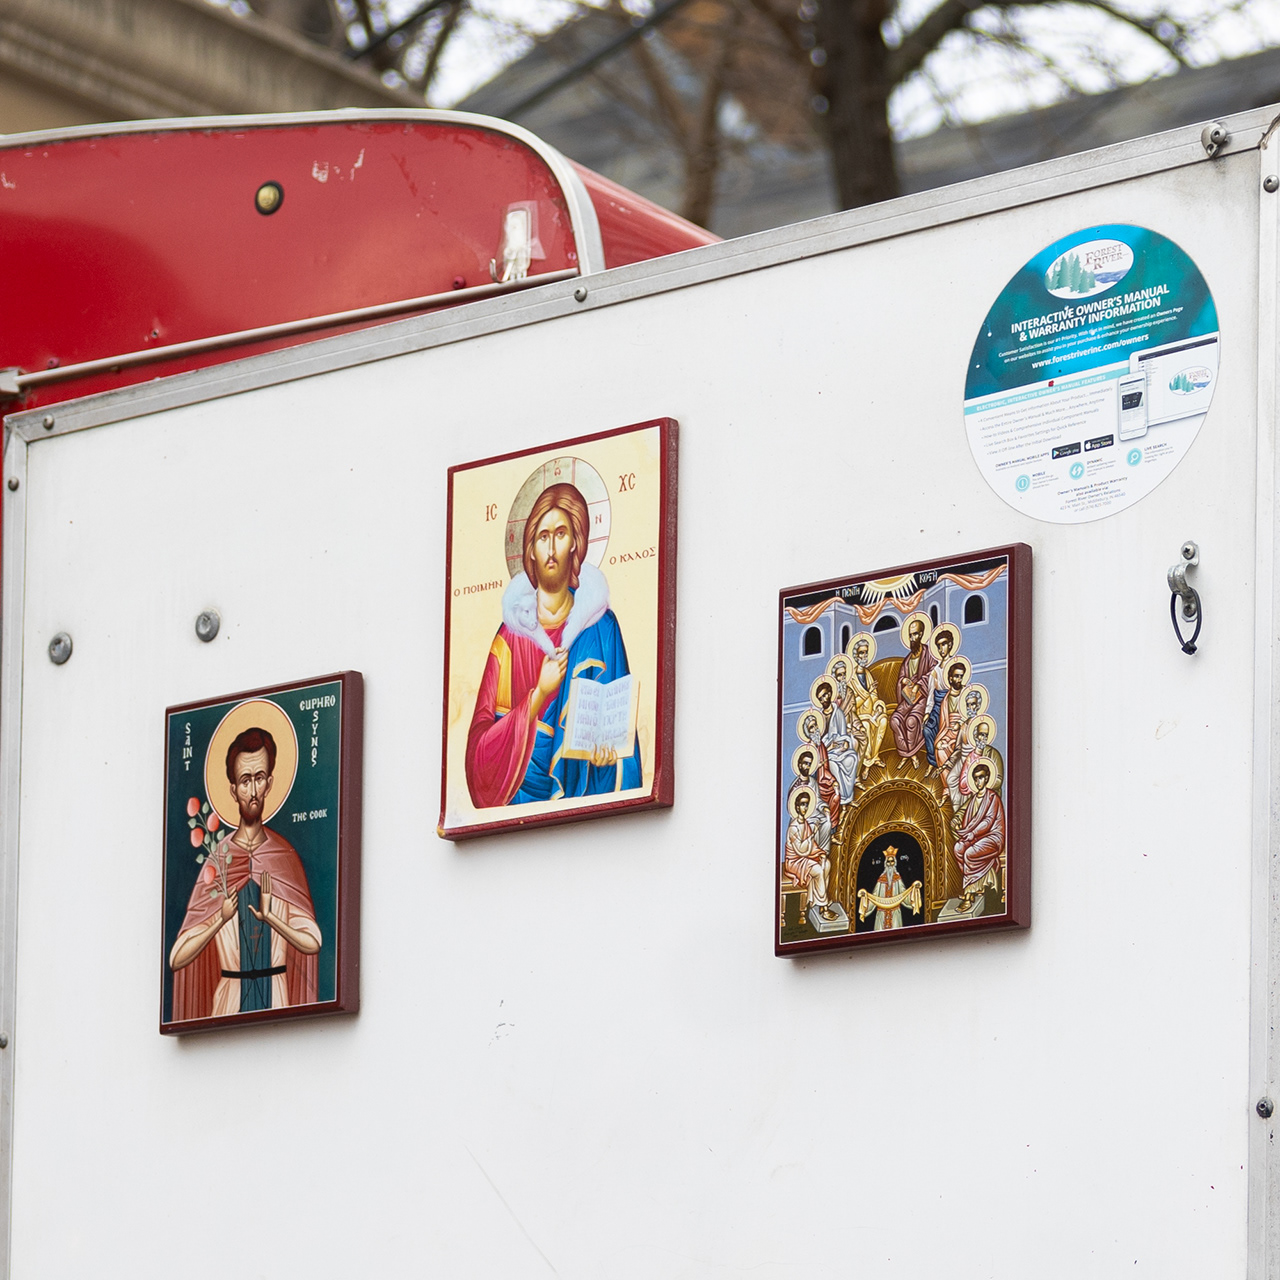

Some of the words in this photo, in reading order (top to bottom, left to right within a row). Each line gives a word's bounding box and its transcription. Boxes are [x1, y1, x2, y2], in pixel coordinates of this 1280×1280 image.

[1011, 311, 1074, 334] INTERACTIVE
[1076, 296, 1122, 318] OWNER'S
[1124, 284, 1170, 305] MANUAL
[1019, 331, 1028, 342] &
[1028, 317, 1087, 340] WARRANTY
[1088, 297, 1161, 322] INFORMATION
[1031, 333, 1149, 369] www.forestriverinc.com/owners
